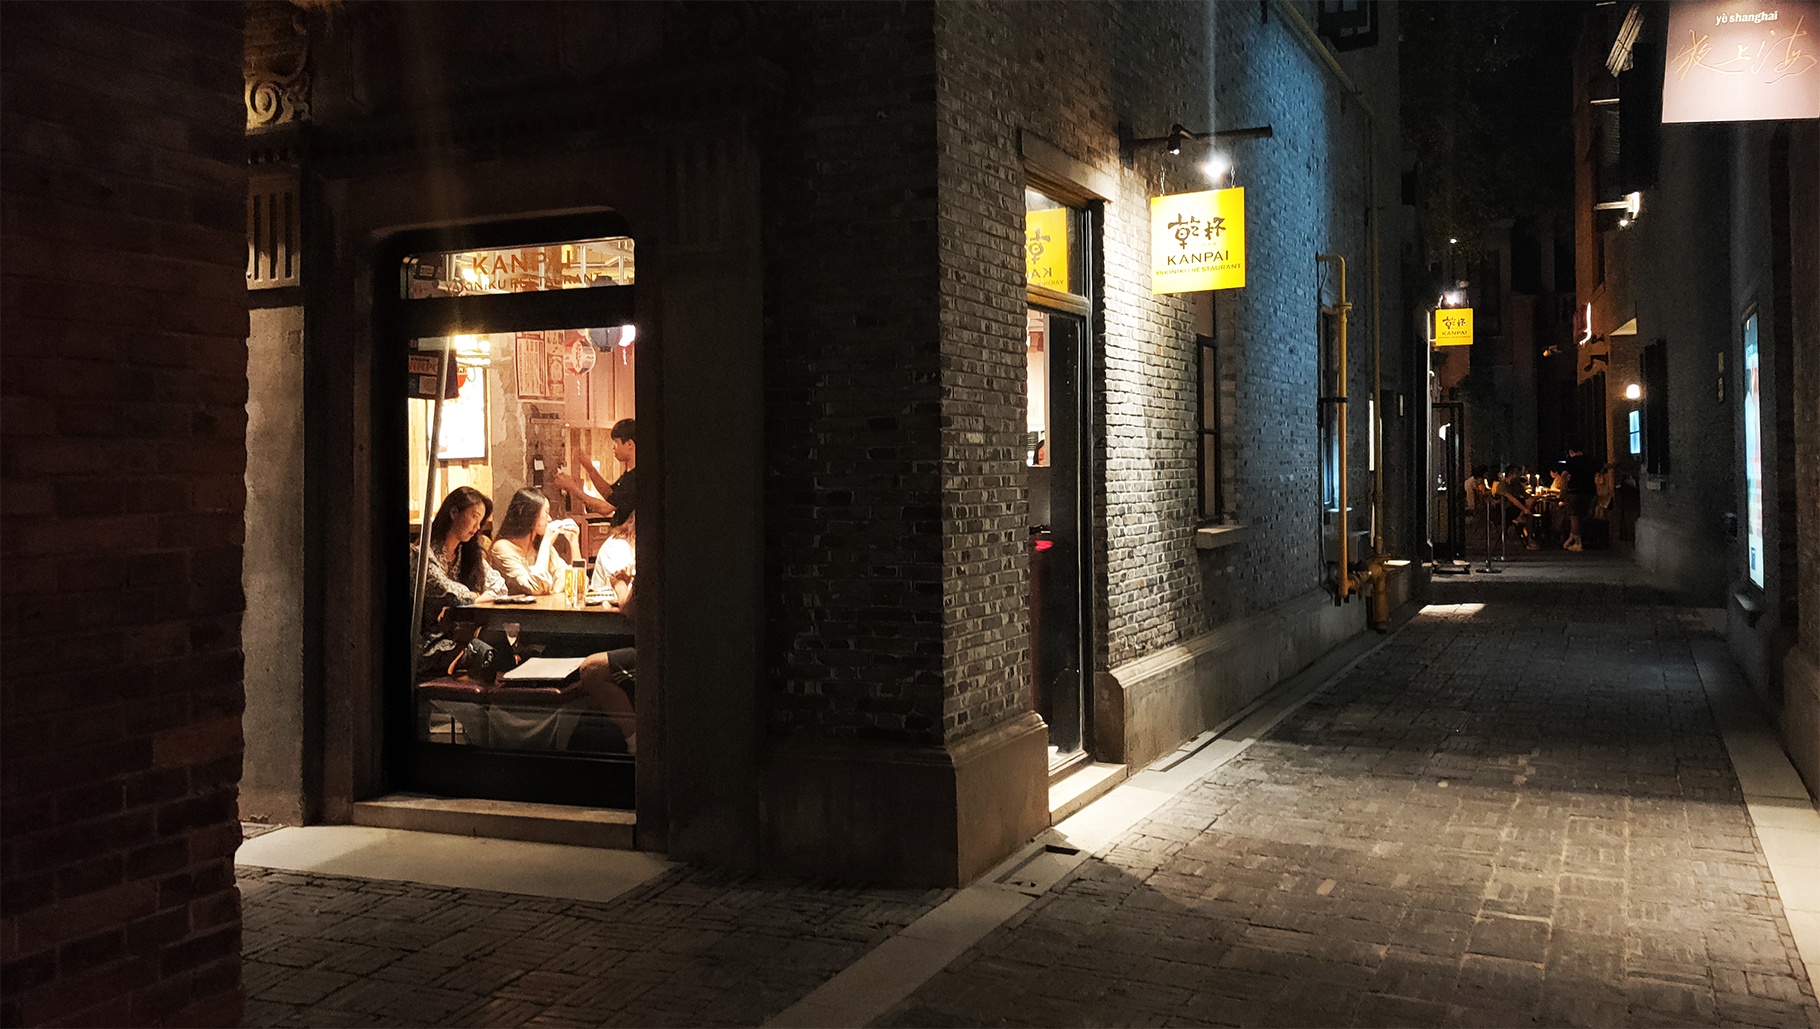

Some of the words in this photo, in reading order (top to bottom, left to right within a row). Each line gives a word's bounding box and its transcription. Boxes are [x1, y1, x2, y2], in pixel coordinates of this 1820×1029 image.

[1715, 13, 1727, 25] yè
[1729, 10, 1778, 24] shanghai
[1671, 15, 1817, 85] 夜上海
[1167, 213, 1226, 249] 乾杯
[472, 250, 571, 275] KANPI
[1167, 250, 1229, 266] KANPAI
[1191, 262, 1242, 273] RESTAURANT
